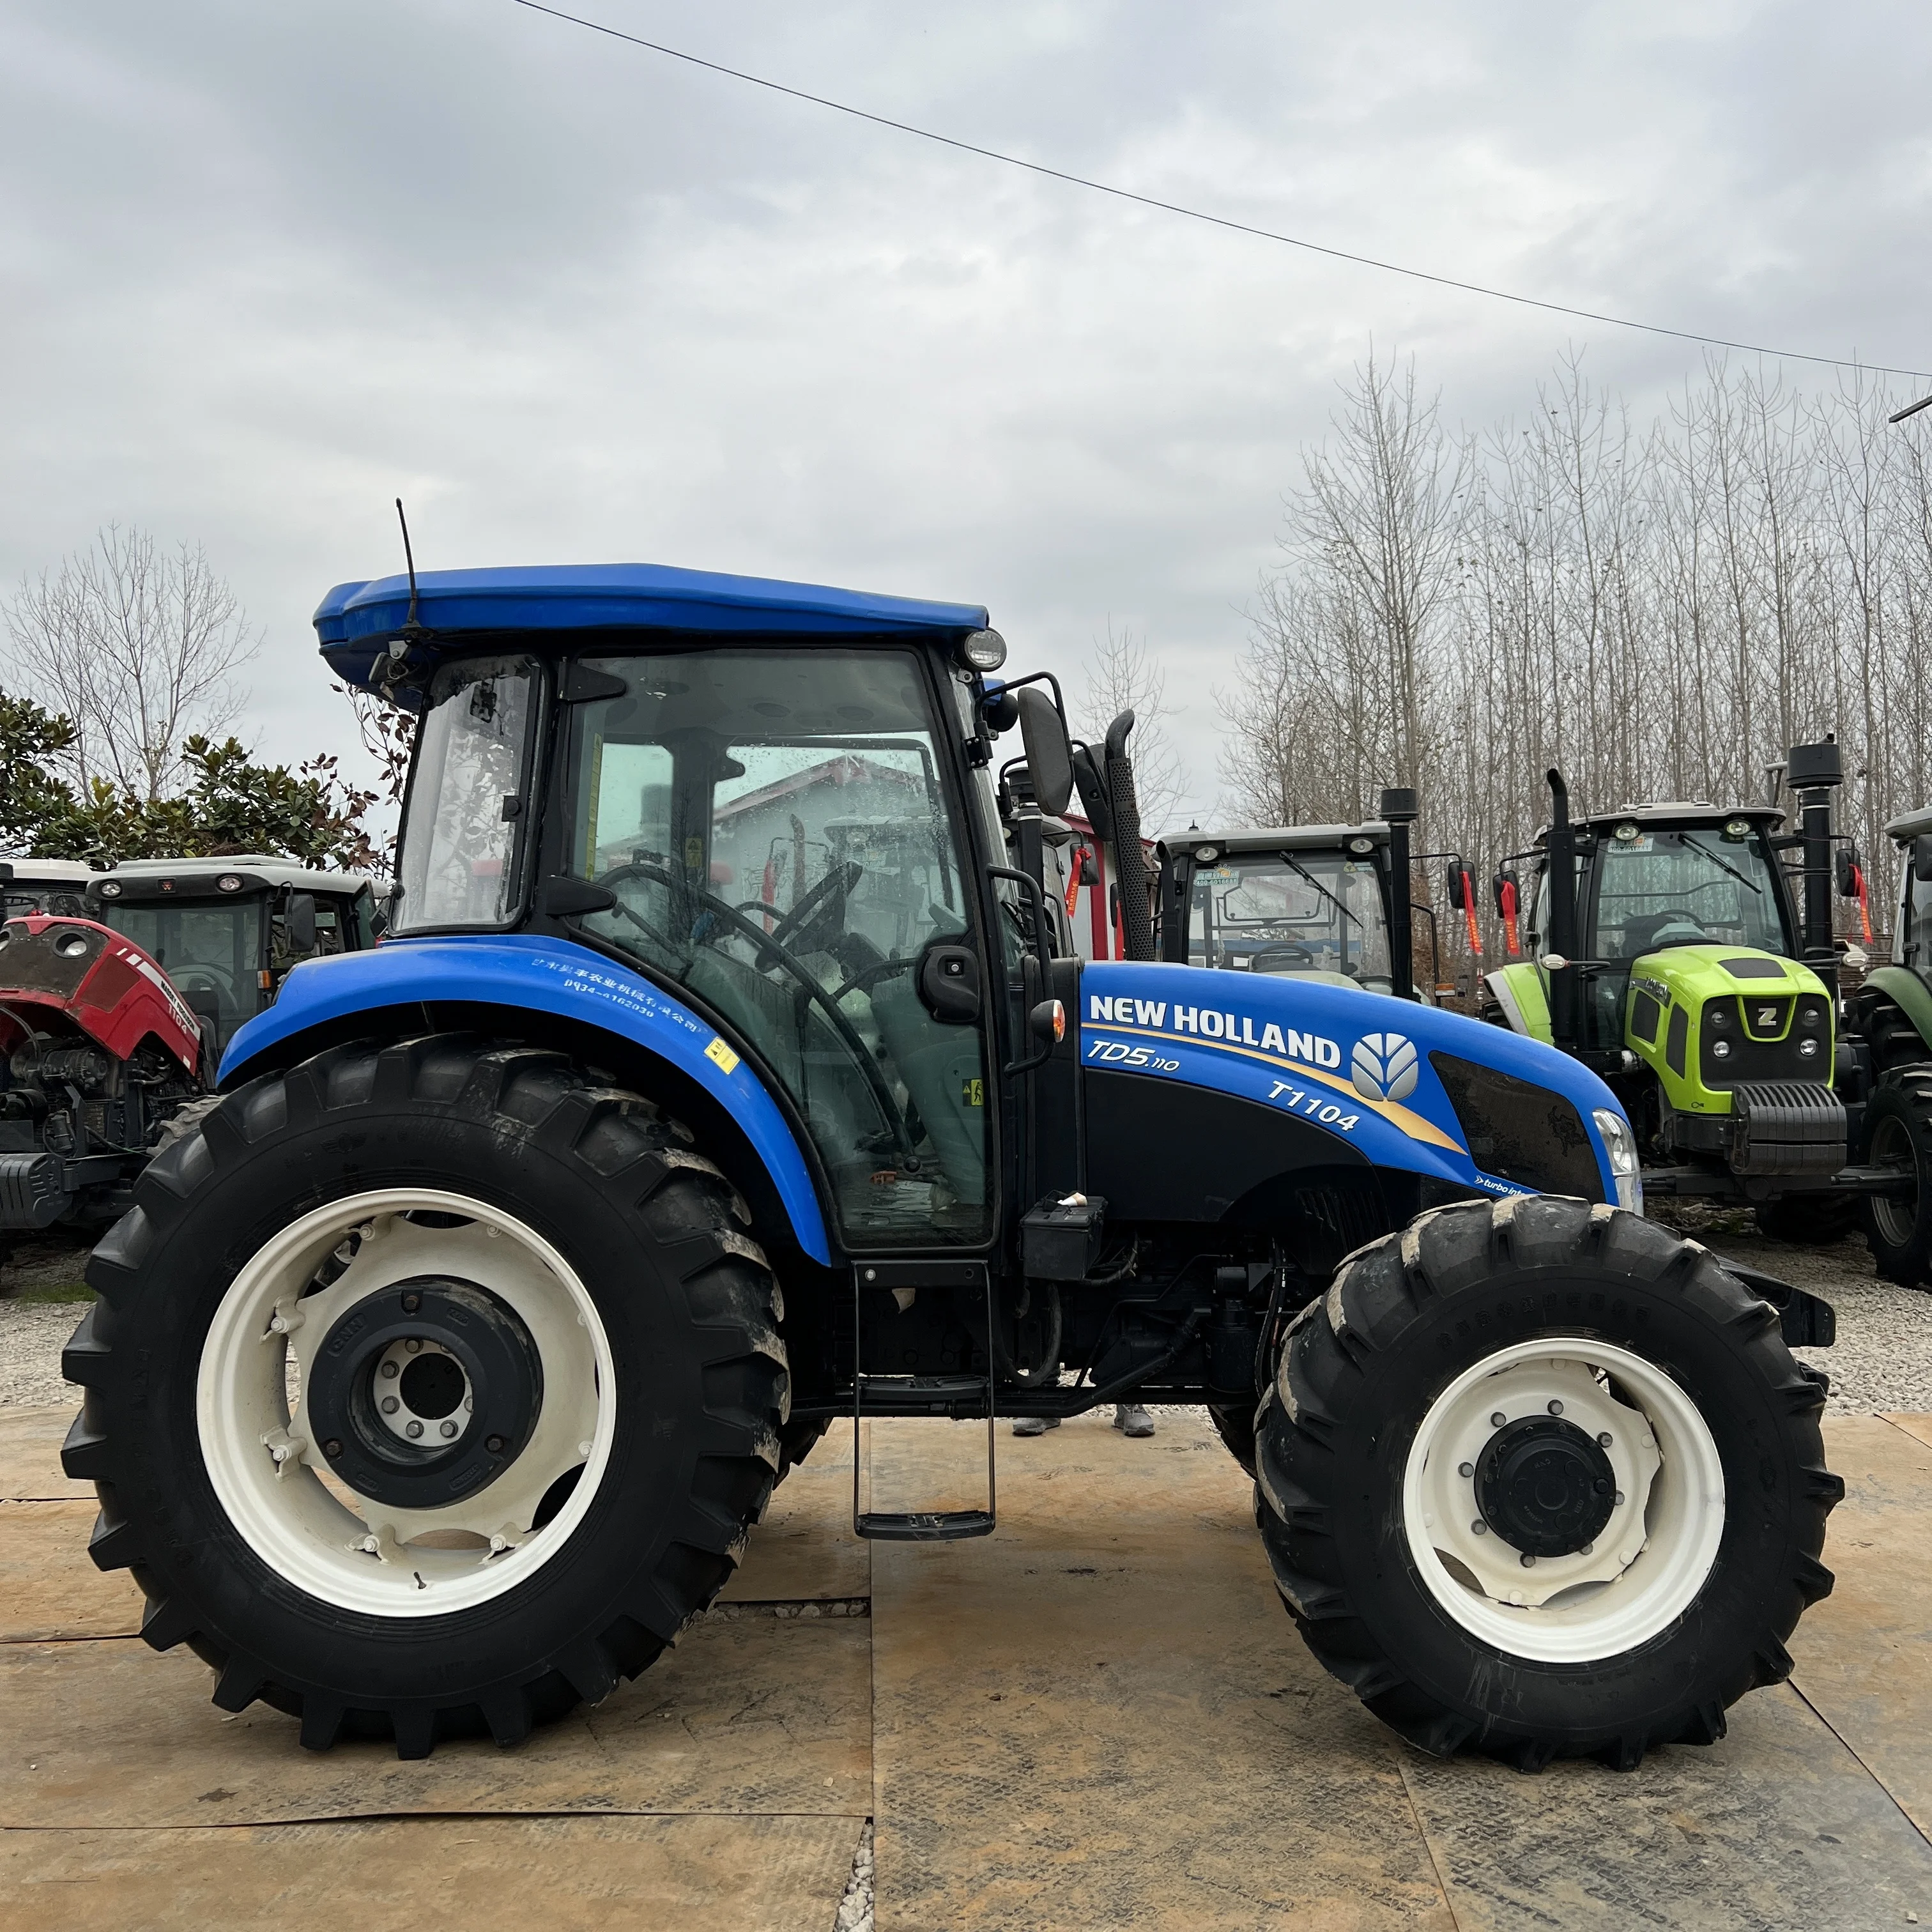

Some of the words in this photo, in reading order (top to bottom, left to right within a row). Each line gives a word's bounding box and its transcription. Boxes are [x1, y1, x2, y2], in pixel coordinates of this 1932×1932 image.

[168, 1003, 187, 1034] 1104
[1090, 995, 1167, 1027] NEW
[1174, 1004, 1342, 1069] HOLLAND
[1087, 1039, 1180, 1072] TD5.110
[1267, 1080, 1360, 1132] T1104
[1483, 1179, 1508, 1193] turbo
